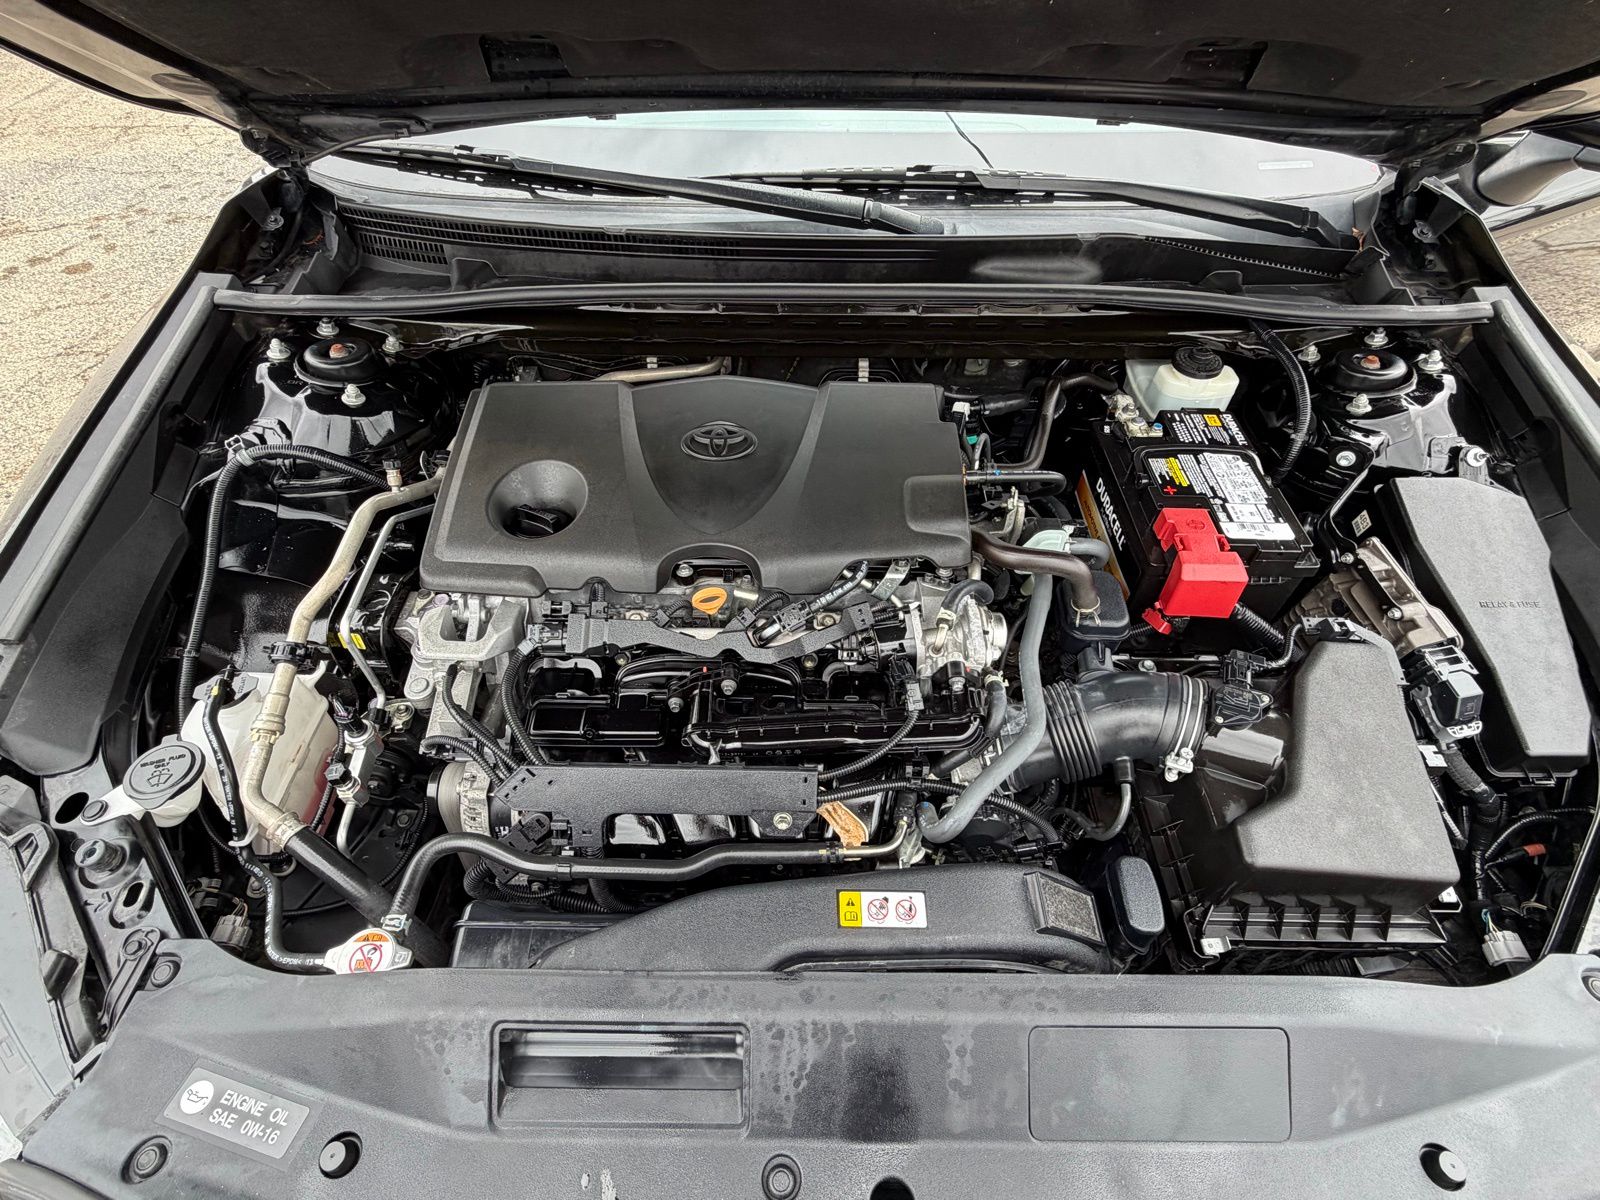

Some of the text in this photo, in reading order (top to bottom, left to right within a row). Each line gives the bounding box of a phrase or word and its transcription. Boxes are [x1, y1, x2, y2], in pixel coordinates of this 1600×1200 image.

[1224, 413, 1249, 446] DURACELL
[1095, 477, 1127, 552] DURACELL
[1479, 601, 1507, 609] RELAY
[1517, 601, 1542, 609] FUSE
[154, 761, 170, 769] ONLY
[219, 1089, 290, 1127] ENGINE OIL
[208, 1108, 280, 1145] SAE 0W-16
